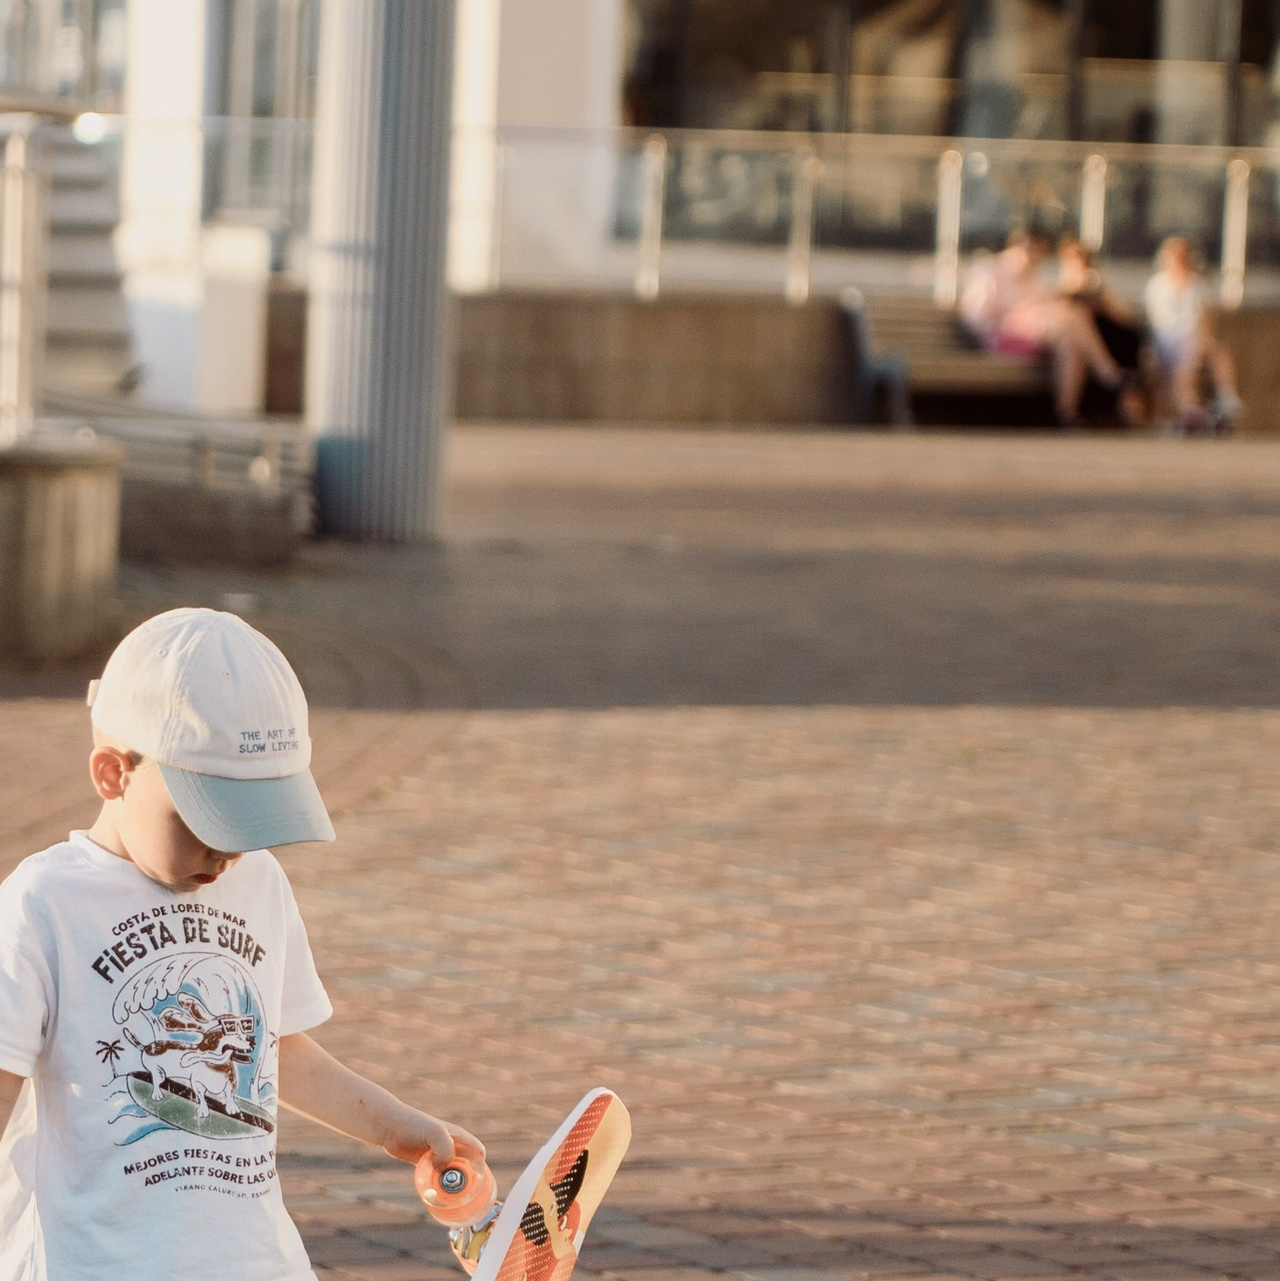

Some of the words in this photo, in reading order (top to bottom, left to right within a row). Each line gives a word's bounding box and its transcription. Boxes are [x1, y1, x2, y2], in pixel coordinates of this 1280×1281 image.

[239, 743, 266, 753] SLOW
[271, 740, 299, 752] LIVING
[240, 731, 262, 741] THE
[267, 729, 284, 740] ART
[288, 728, 296, 737] OF
[111, 911, 150, 936] COSTA
[152, 906, 167, 918] DE
[171, 903, 205, 914] LORET
[207, 907, 219, 918] DE
[222, 911, 246, 929] MAR
[182, 916, 211, 944] DE
[217, 923, 267, 967] SURF
[123, 1150, 180, 1175] MEJORES
[184, 1148, 232, 1165] FIESTAS
[235, 1157, 251, 1168] EN
[254, 1154, 268, 1166] LA
[144, 1166, 205, 1187] ADELANTE
[207, 1167, 244, 1184] SOBRE
[247, 1173, 266, 1185] LAS
